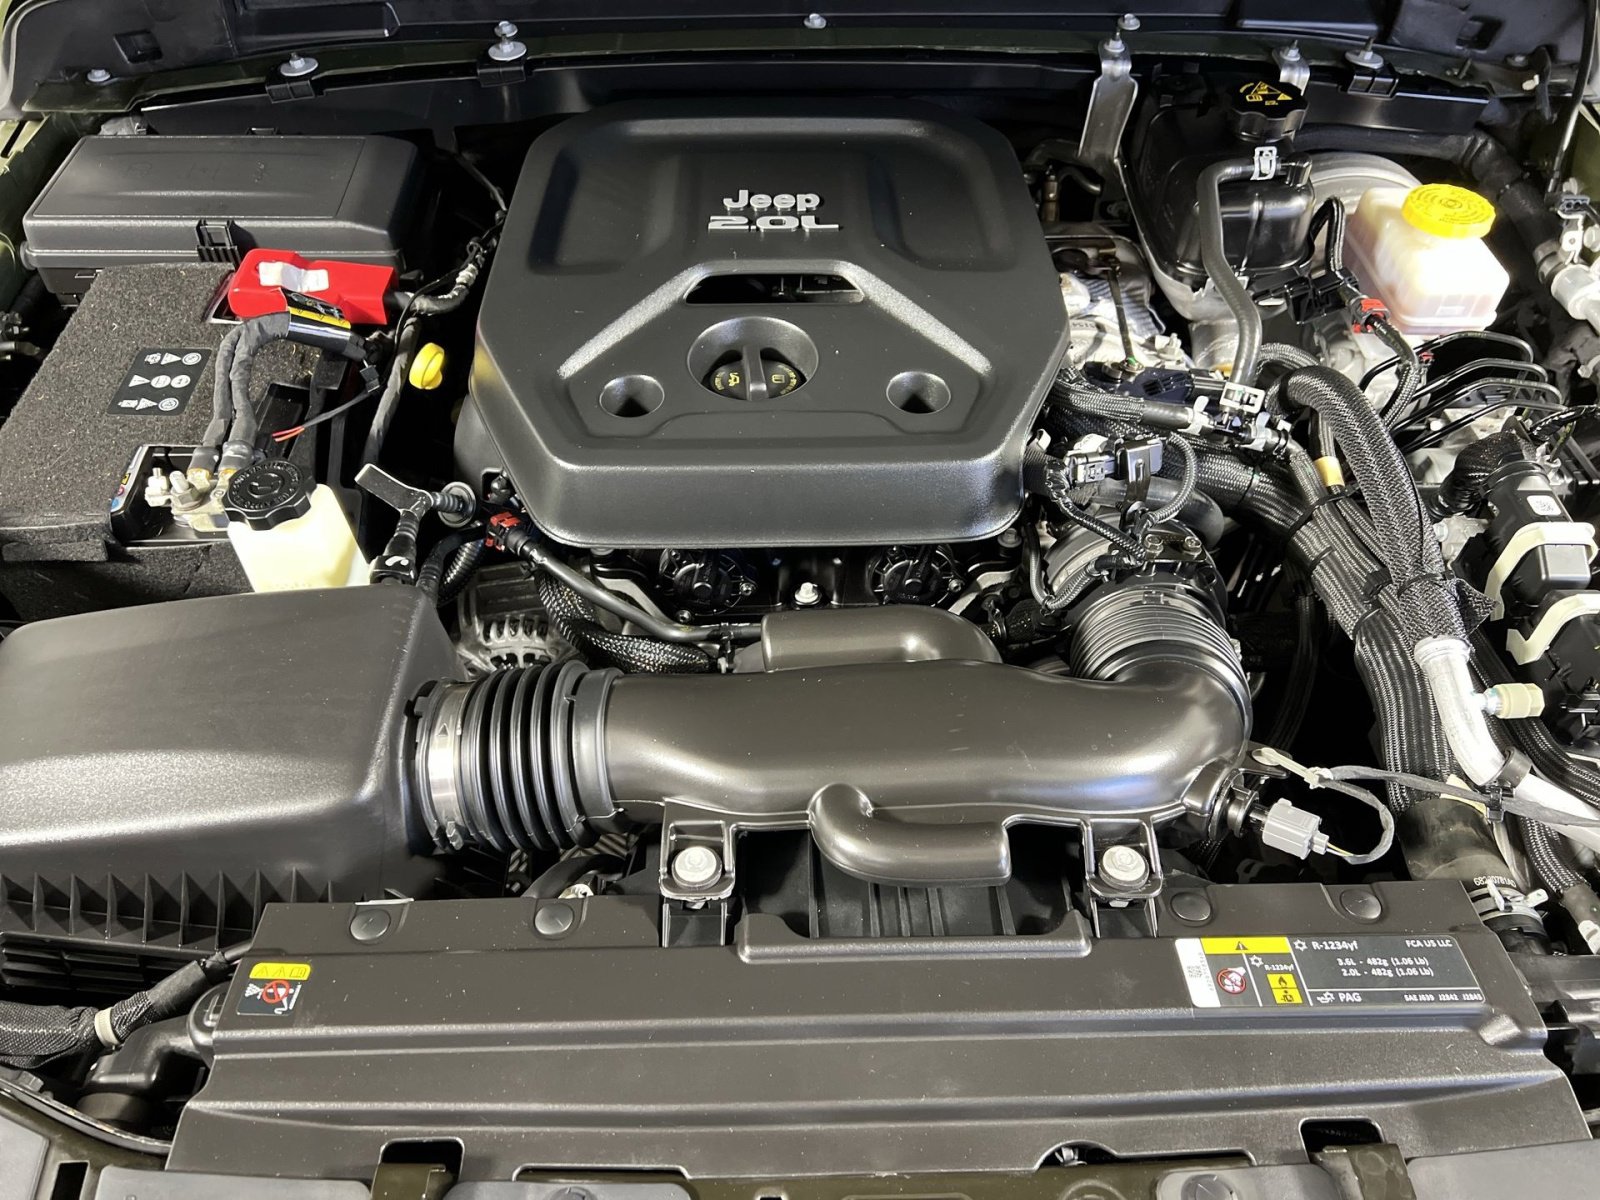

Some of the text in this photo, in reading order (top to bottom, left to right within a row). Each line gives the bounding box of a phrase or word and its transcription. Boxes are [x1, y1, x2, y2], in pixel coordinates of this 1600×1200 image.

[723, 189, 820, 212] Jeep
[708, 215, 839, 232] 2.0L
[1312, 940, 1359, 951] R-1234yf
[1405, 939, 1453, 948] FCA US LLC
[1336, 957, 1356, 966] 3.6L
[1367, 957, 1389, 967] 482g
[1390, 956, 1414, 967] (1.06
[1413, 956, 1430, 967] Lb)
[1341, 968, 1361, 977] 2.0L
[1371, 967, 1394, 978] 482g
[1395, 967, 1419, 978] (1.06
[1418, 966, 1435, 977] Lb)
[1338, 992, 1362, 1002] PAG
